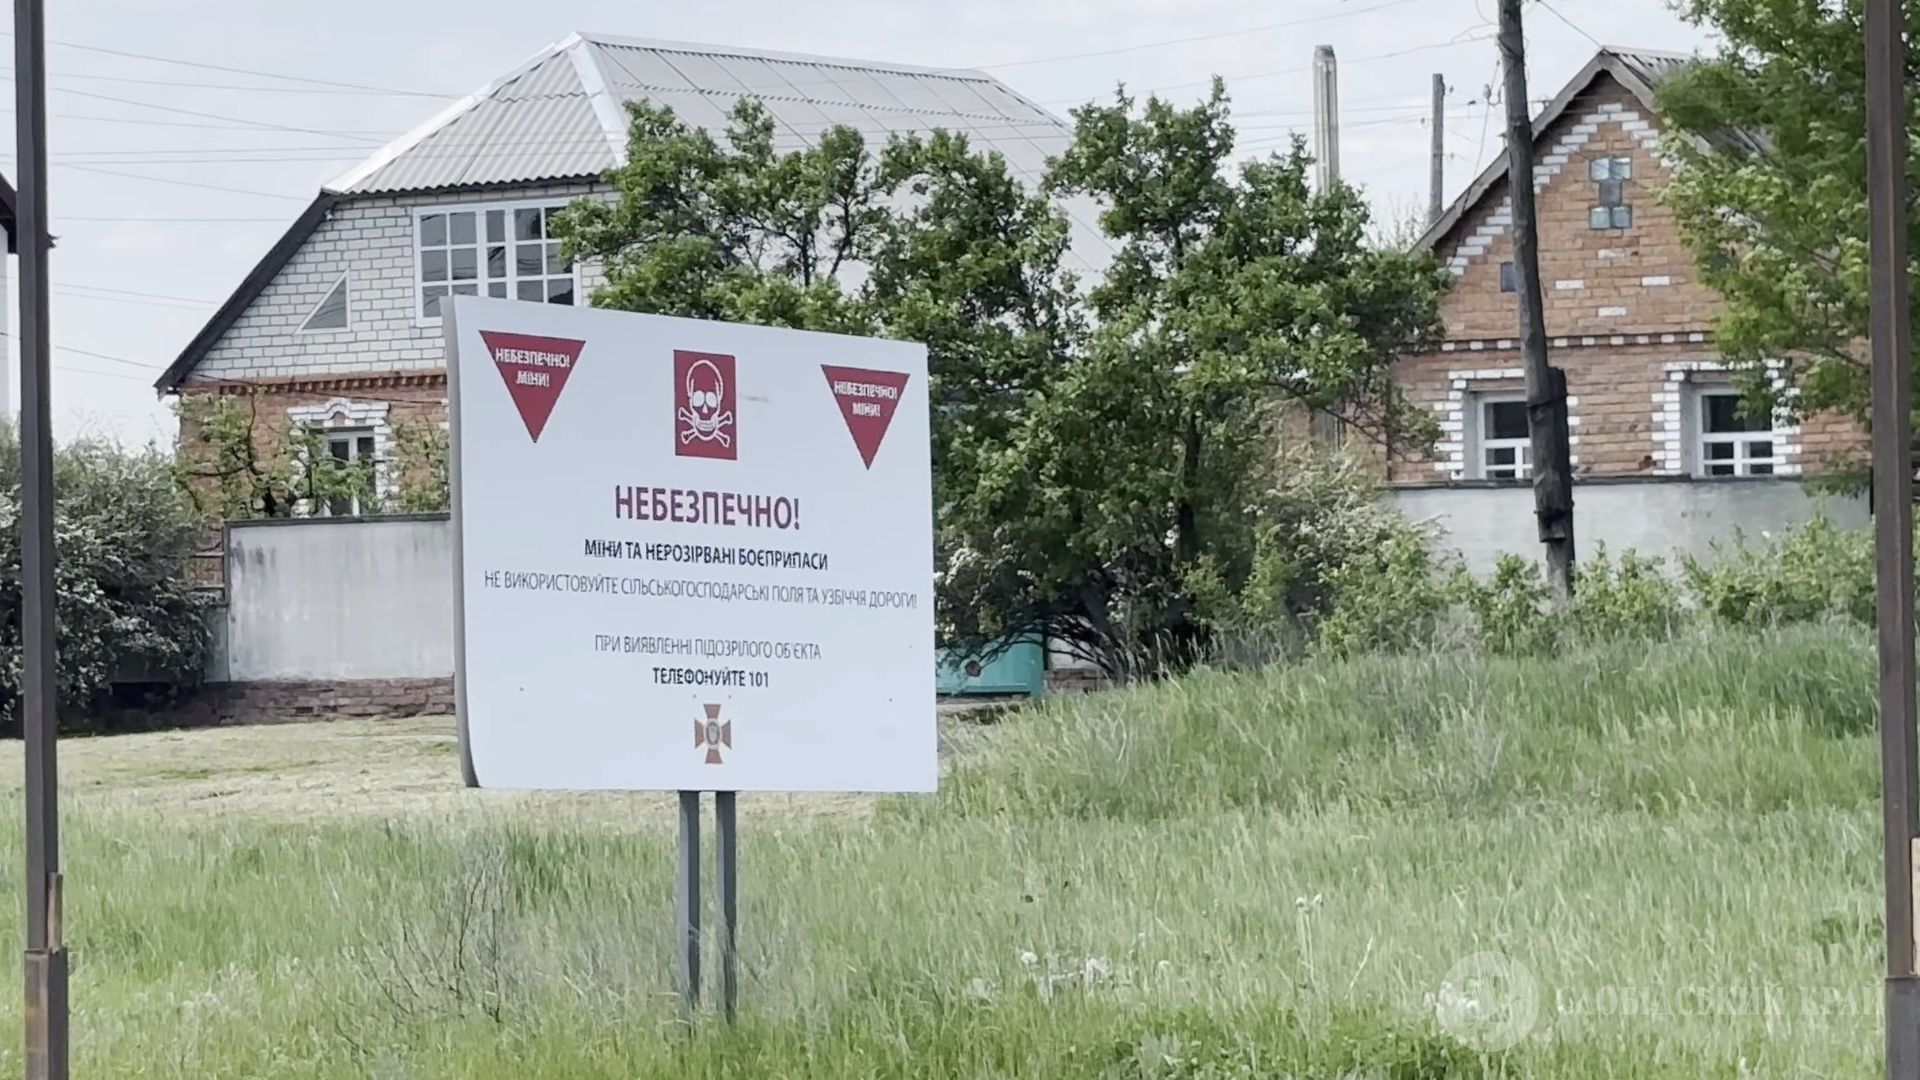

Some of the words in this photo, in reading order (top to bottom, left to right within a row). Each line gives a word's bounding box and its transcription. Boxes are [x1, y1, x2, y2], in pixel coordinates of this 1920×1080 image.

[496, 347, 570, 368] НЕБЕЗПЕЧНО!
[615, 485, 800, 529] НЕБЕЗПЕЧНО!
[585, 539, 621, 559] МІНИ
[625, 542, 642, 560] ТА
[646, 543, 736, 565] НЕРОЗІРВАНІ
[739, 547, 828, 570] БОЄПРИПАСИ
[485, 570, 501, 588] НЕ
[504, 570, 618, 594] ВИКОРИСТОВУЙТЕ
[621, 578, 768, 602] СІЛЬСЬКОГОСПОДАРСЬКІ
[772, 586, 803, 603] ПОЛЯ
[806, 587, 819, 604] ТА
[821, 588, 866, 606] УЗБІЧЧЯ
[869, 590, 917, 609] ДОРОГИ!
[595, 635, 621, 652] ПРИ
[624, 635, 692, 655] ВИЯВЛЕННІ
[695, 638, 772, 659] ПІДОЗРІЛОГО
[652, 667, 746, 687] ТЕЛЕФОНУЙТЕ
[749, 671, 769, 687] 101
